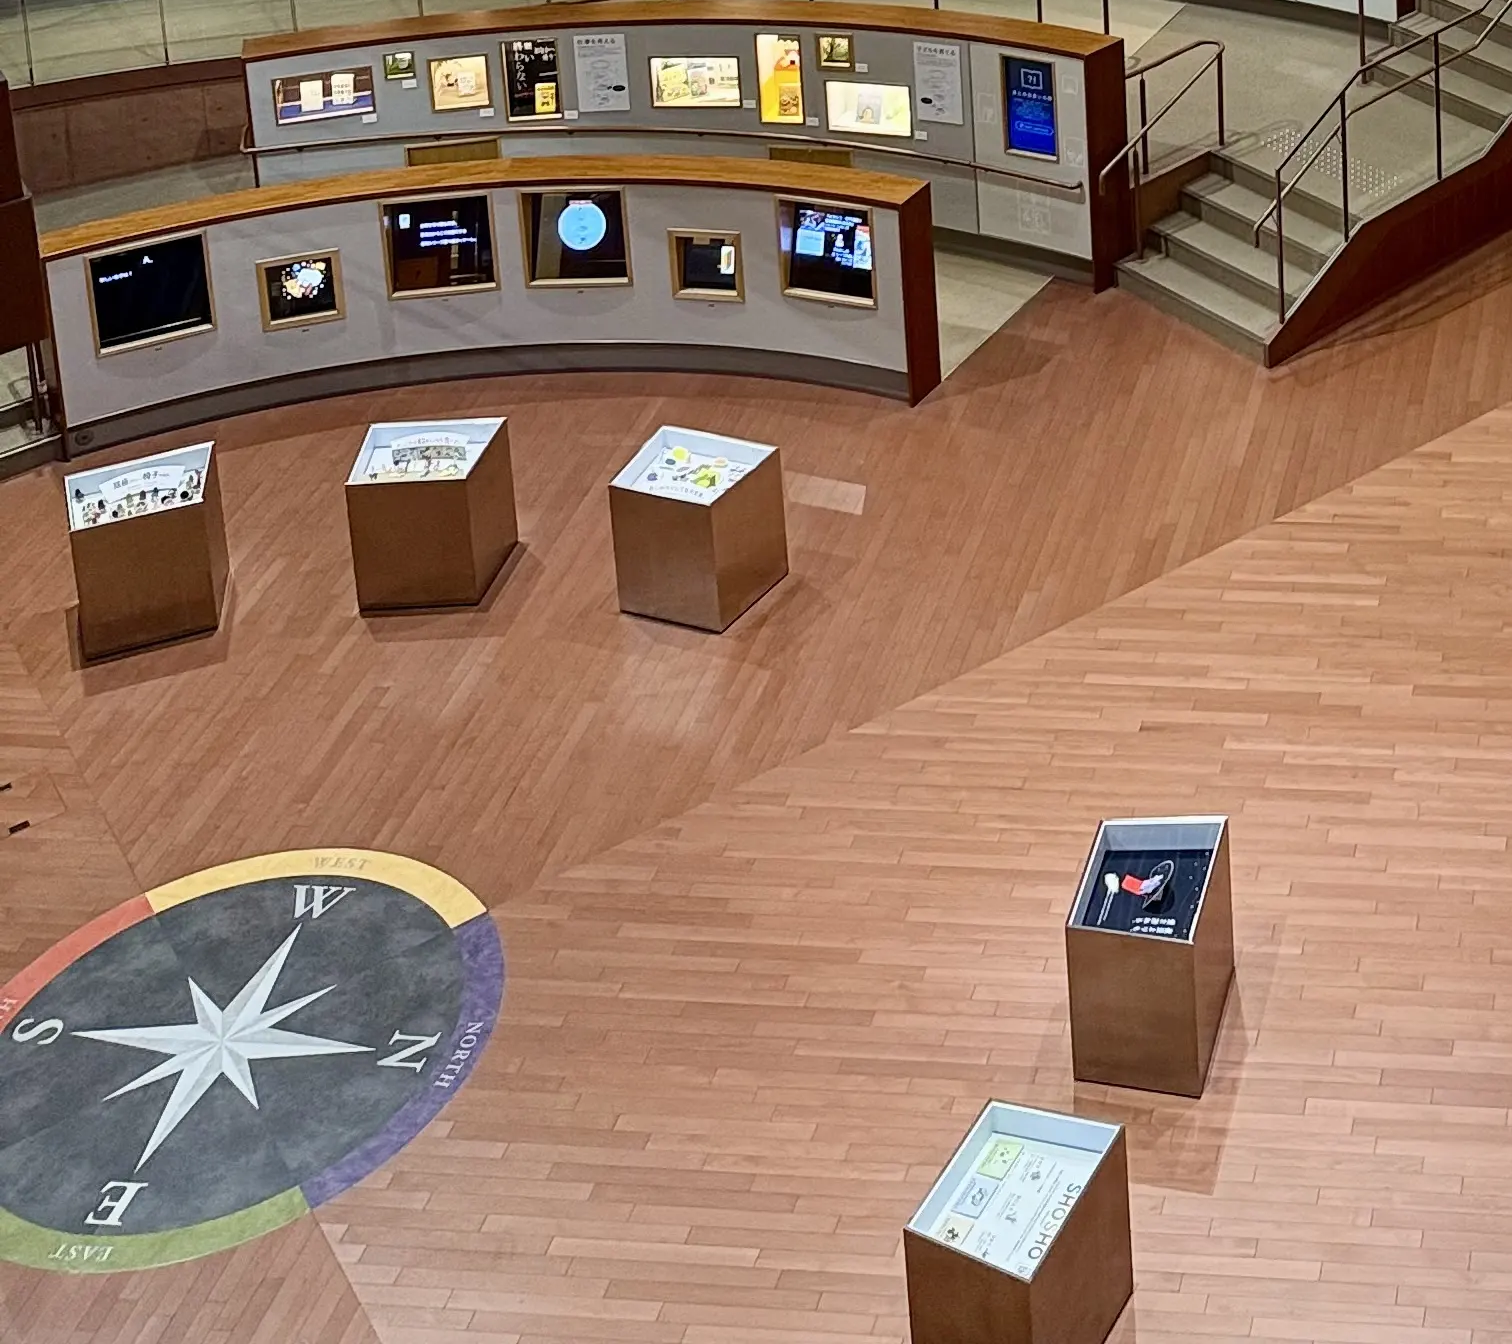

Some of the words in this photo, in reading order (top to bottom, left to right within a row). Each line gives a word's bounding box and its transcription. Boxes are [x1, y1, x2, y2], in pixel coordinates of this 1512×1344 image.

[314, 854, 372, 873] WEST
[292, 884, 356, 920] W
[12, 1017, 64, 1045] S
[376, 1029, 443, 1074] N
[432, 1020, 485, 1089] NORTH
[84, 1180, 149, 1227] E
[1027, 1182, 1083, 1261] SHOSHO
[48, 1243, 114, 1263] EAST
